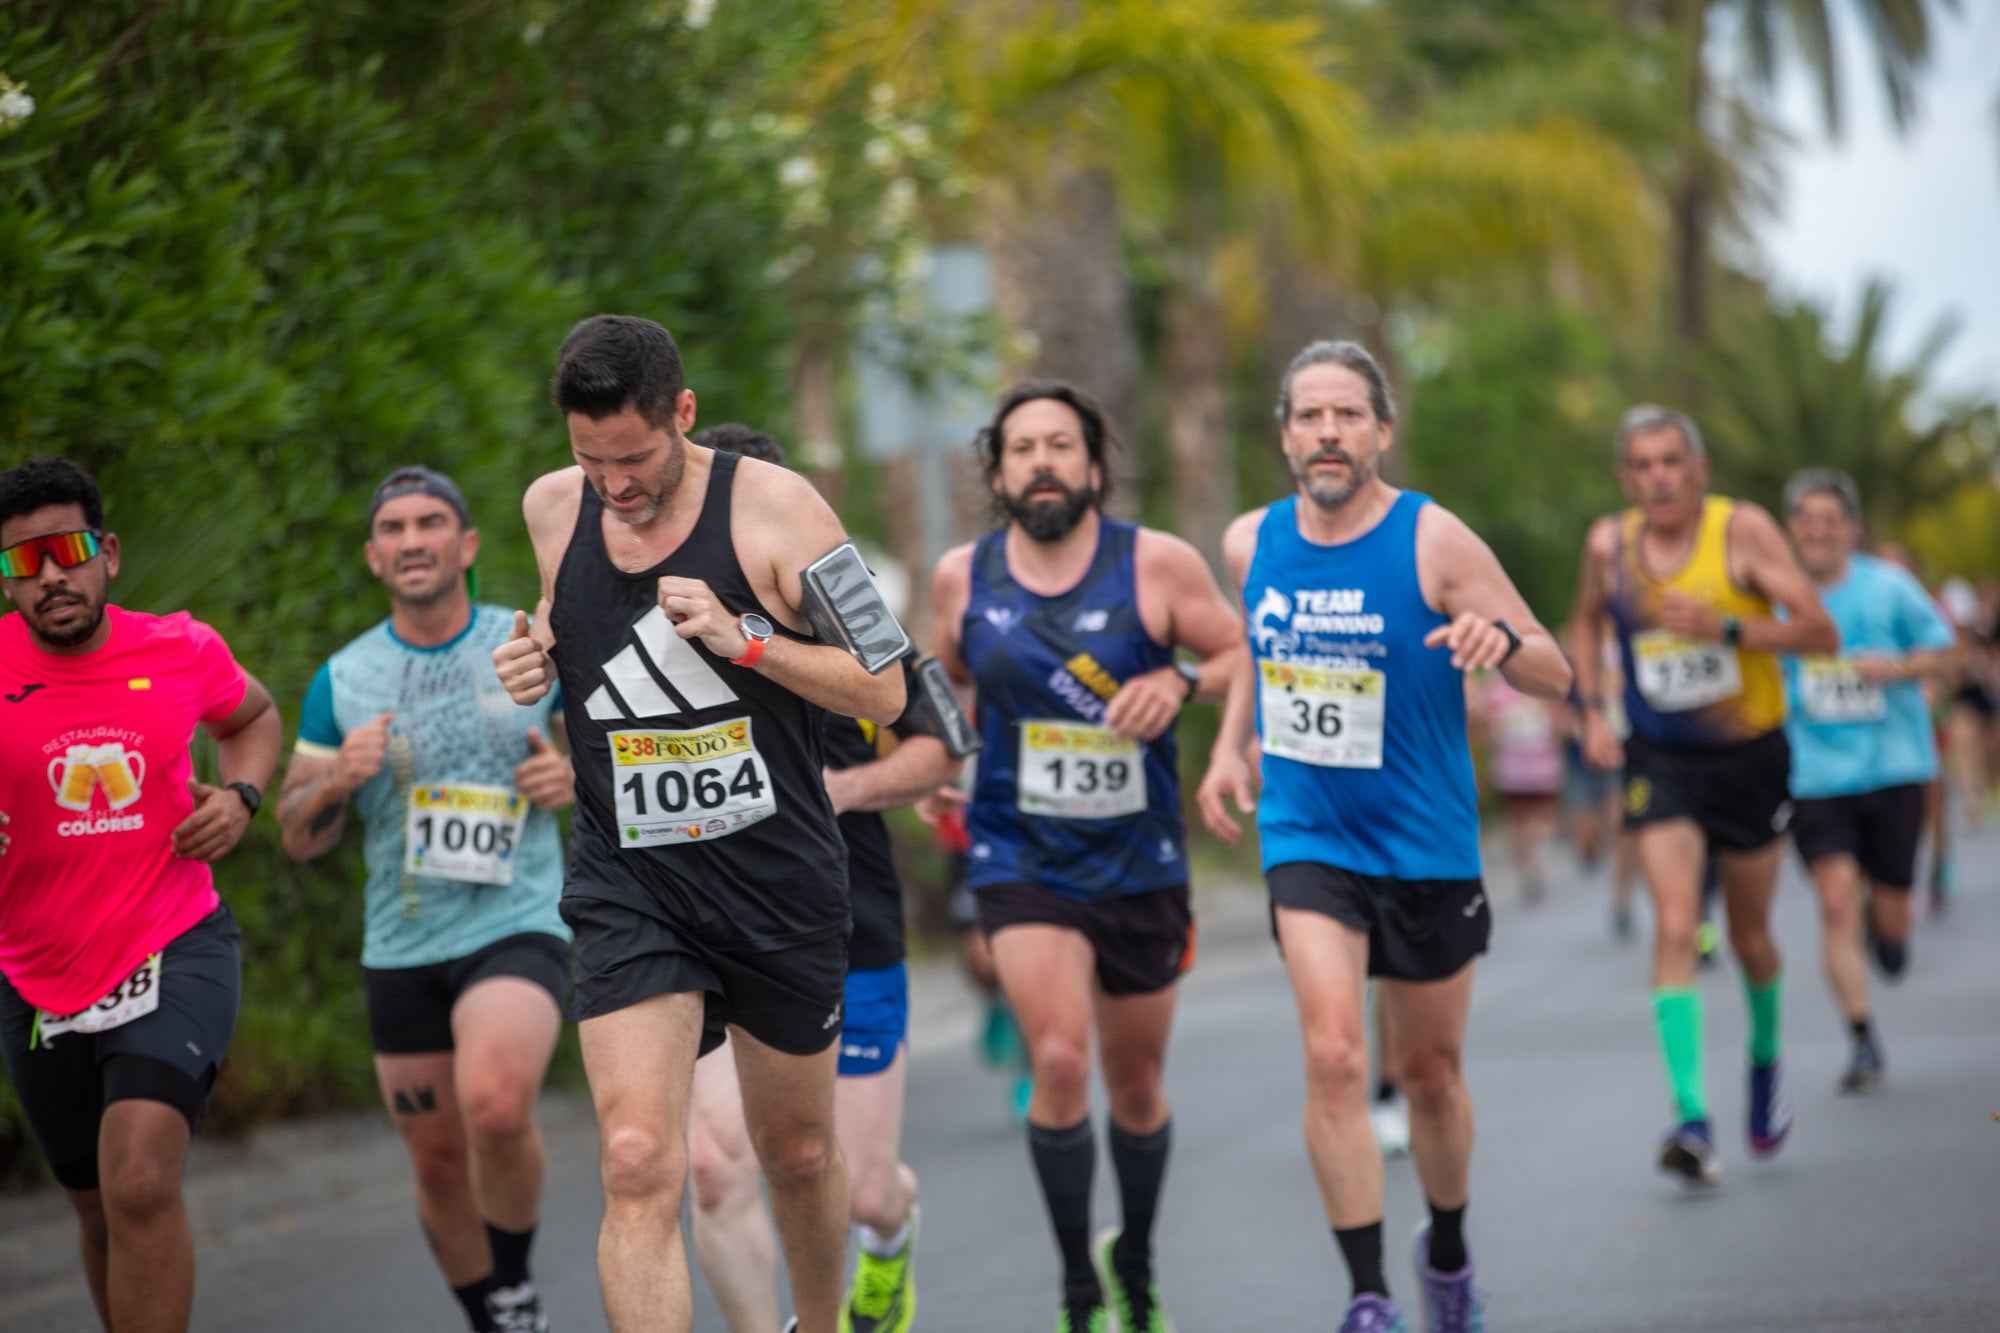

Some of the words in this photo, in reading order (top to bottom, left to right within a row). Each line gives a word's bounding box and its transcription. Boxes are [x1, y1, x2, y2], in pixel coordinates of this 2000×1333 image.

[1294, 589, 1365, 614] TEAM
[1291, 613, 1384, 635] RUNNING
[1291, 699, 1342, 737] 36
[42, 726, 144, 755] RESTAURANTE
[632, 737, 655, 757] 38
[655, 737, 727, 757] FONDO
[623, 757, 764, 815] 1064
[1046, 758, 1130, 793] 139
[57, 813, 144, 837] COLORES
[416, 816, 514, 859] 1005
